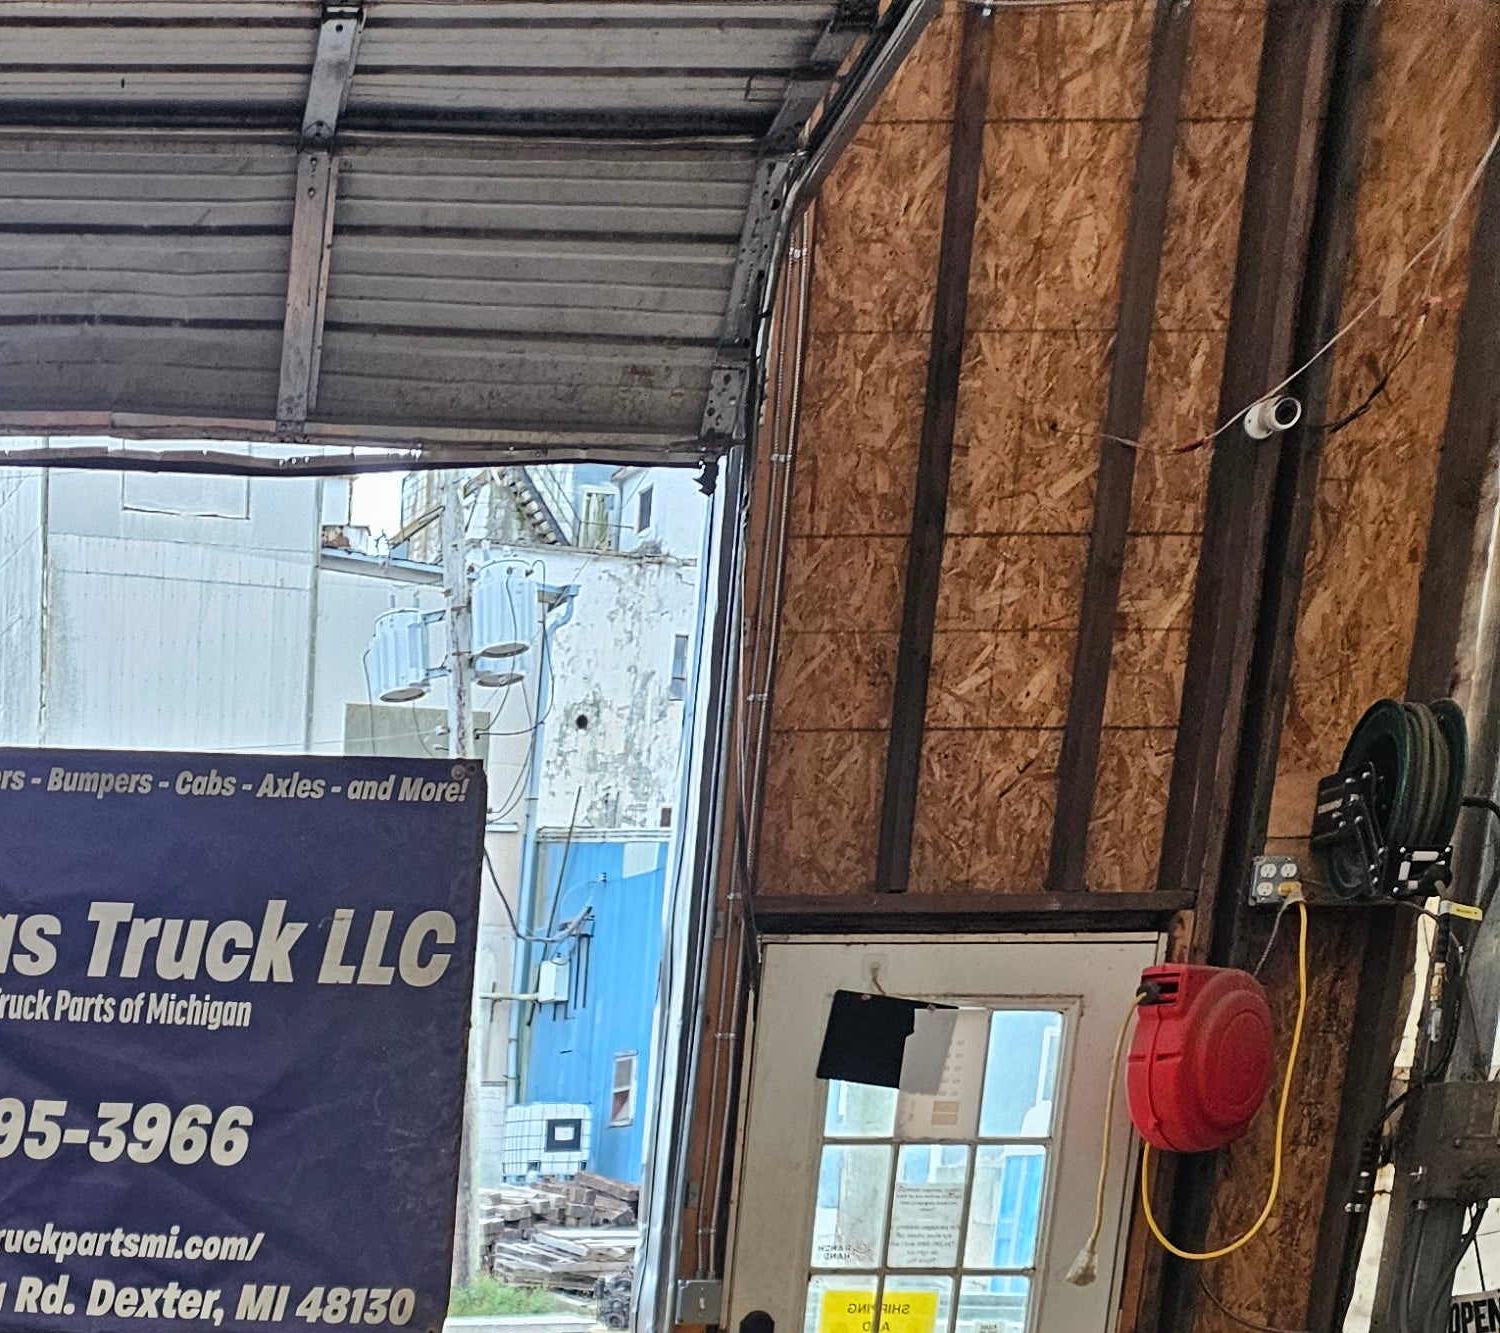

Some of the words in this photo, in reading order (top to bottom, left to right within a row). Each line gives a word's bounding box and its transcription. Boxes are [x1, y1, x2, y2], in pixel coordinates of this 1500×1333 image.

[47, 766, 153, 799] Bumpers
[175, 769, 237, 797] Cabs
[256, 772, 326, 799] Axles
[346, 774, 396, 801] and
[398, 776, 470, 803] More!
[87, 899, 308, 984] Truck
[317, 908, 457, 988] LLC
[55, 989, 117, 1024] Parts
[119, 993, 146, 1026] of
[148, 992, 253, 1032] Michigan
[14, 1274, 77, 1317] Rd.
[84, 1279, 226, 1329] Dexter,
[235, 1283, 292, 1323] MI
[294, 1286, 417, 1327] 48130
